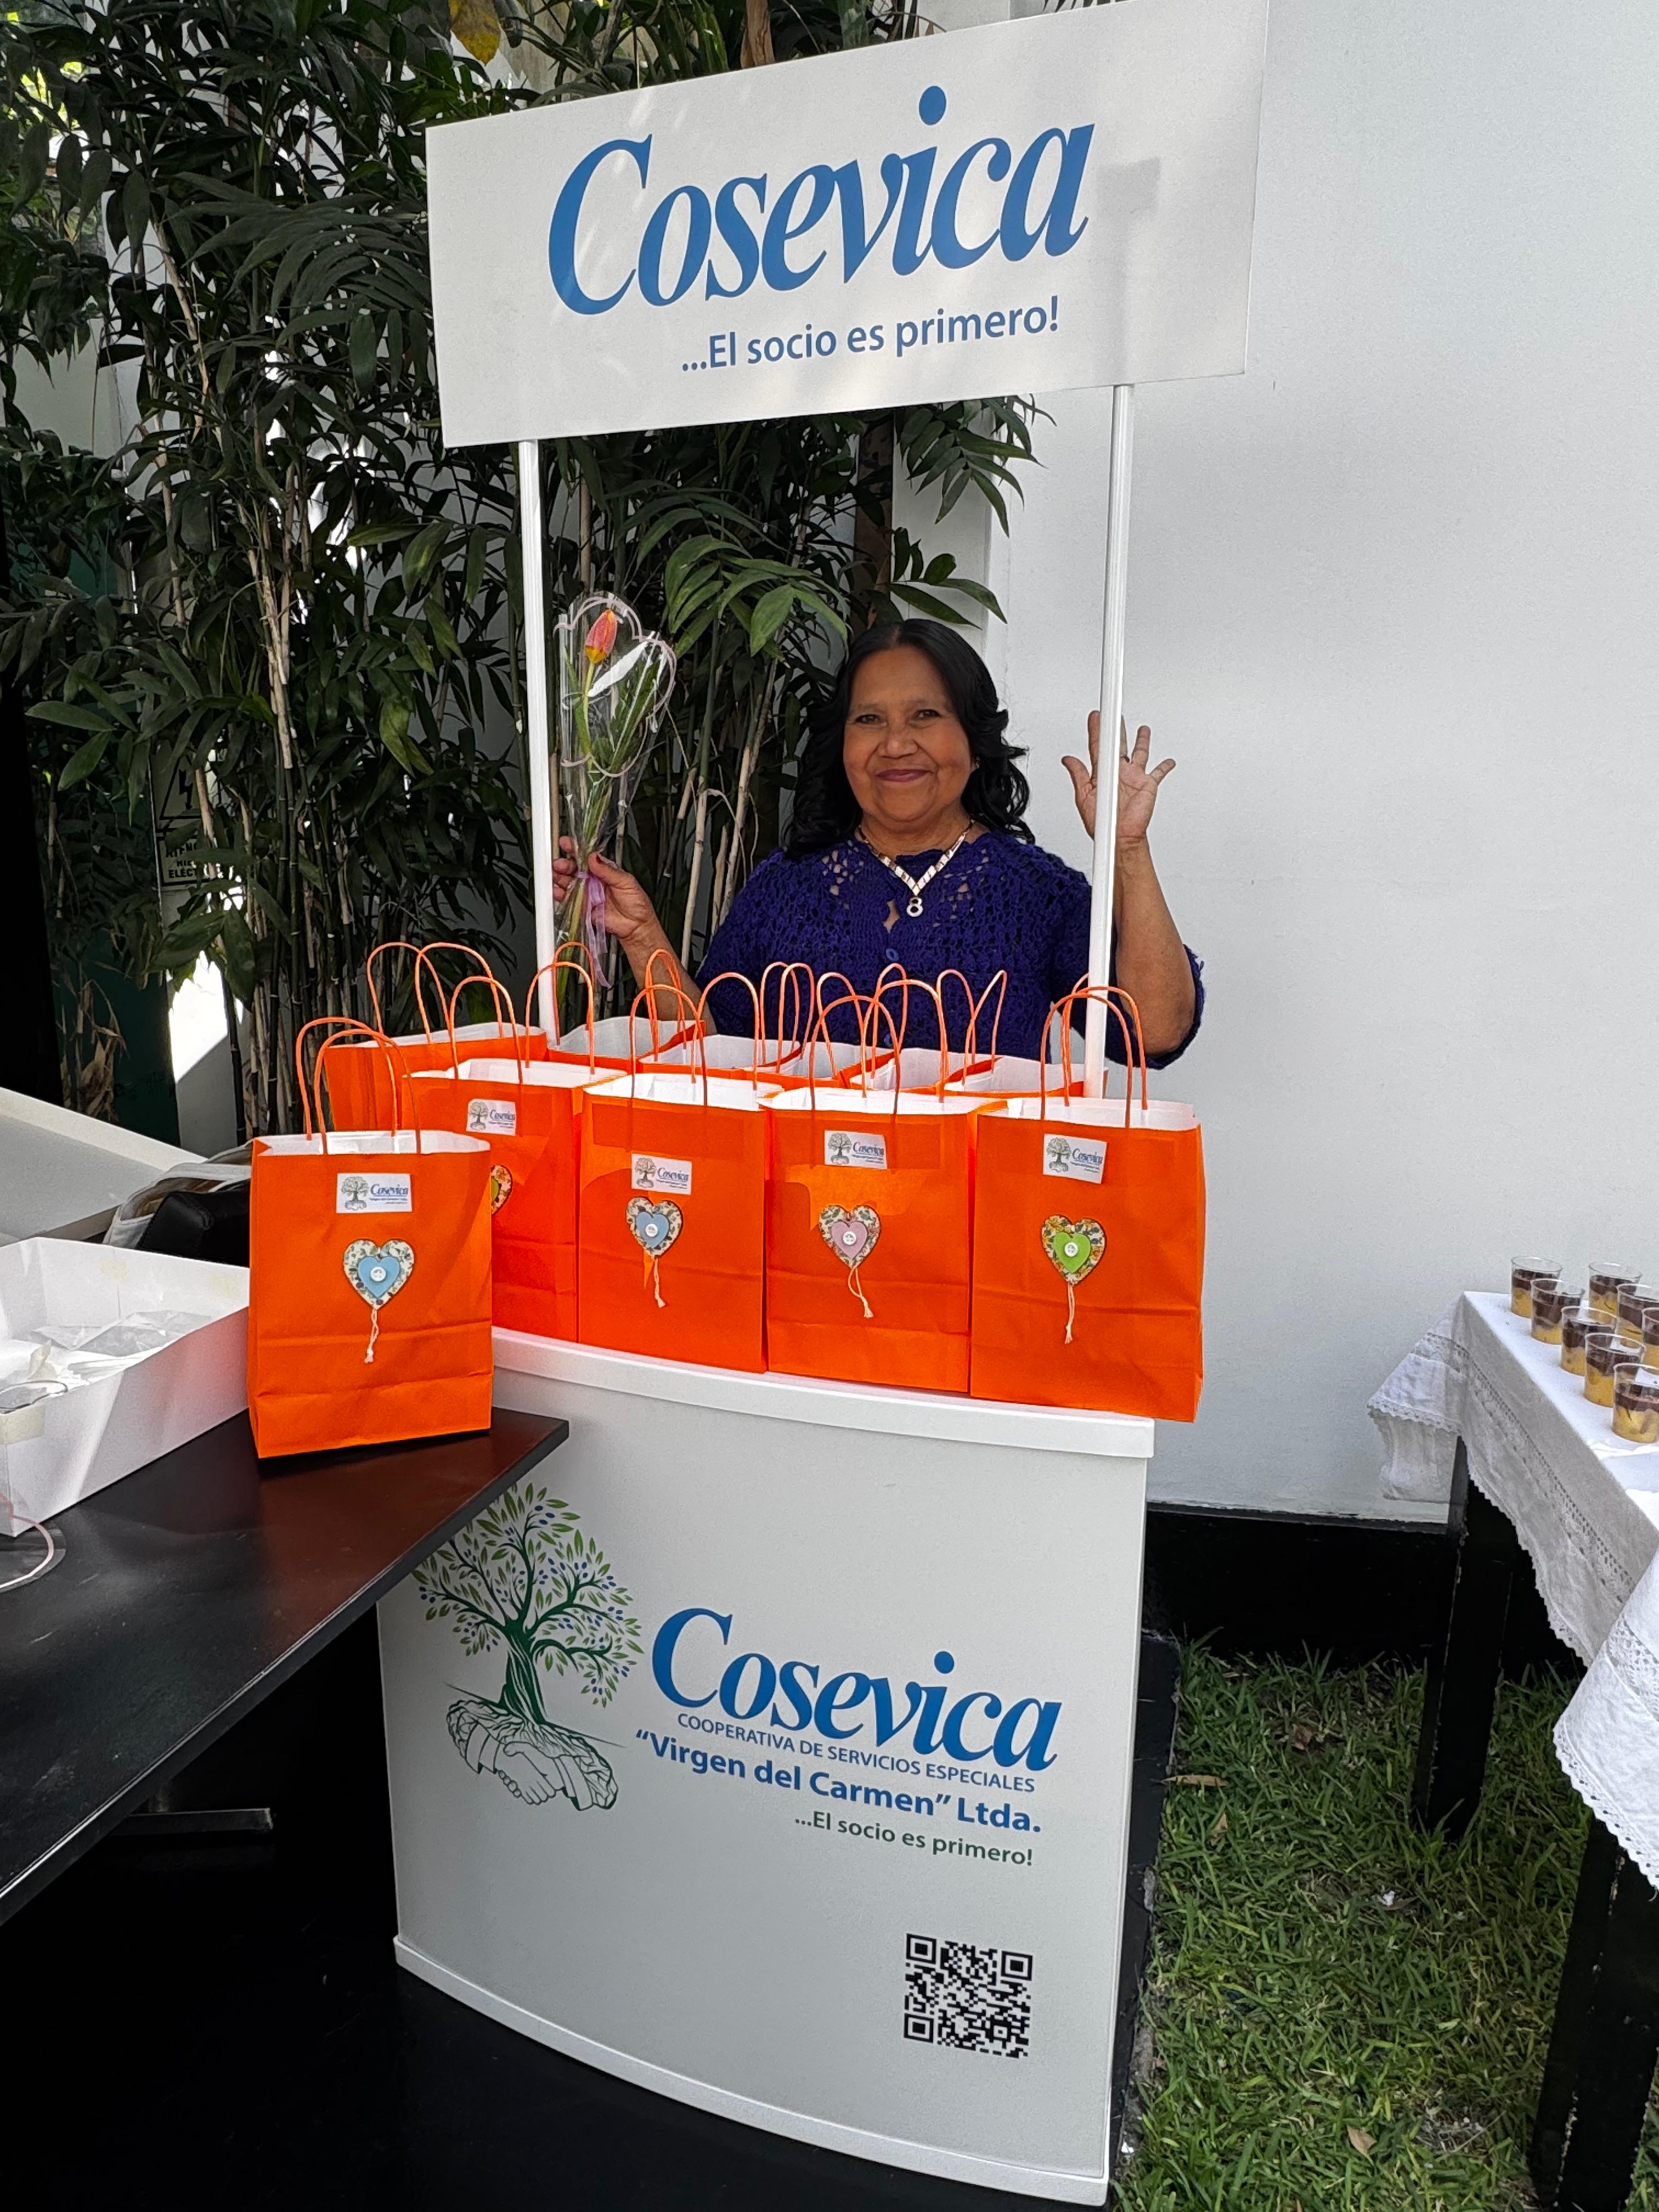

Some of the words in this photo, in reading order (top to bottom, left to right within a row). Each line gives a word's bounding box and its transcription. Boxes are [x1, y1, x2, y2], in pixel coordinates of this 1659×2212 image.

[549, 86, 1094, 315] Cosevica
[682, 331, 736, 372] ...El
[747, 324, 837, 364] socio
[847, 325, 884, 353] es
[896, 295, 1058, 357] primero!
[652, 1607, 1062, 1771] Cosevica
[678, 1713, 795, 1753] COOPERATIVA
[800, 1740, 823, 1757] DE
[827, 1746, 921, 1775] SERVICIOS
[926, 1763, 1035, 1792] ESPECIALES
[754, 1759, 801, 1791] del
[957, 1797, 1041, 1832] Ltda.
[795, 1810, 831, 1830] ...El
[837, 1820, 895, 1842] socio
[902, 1832, 926, 1848] es
[933, 1838, 1032, 1866] primero!
